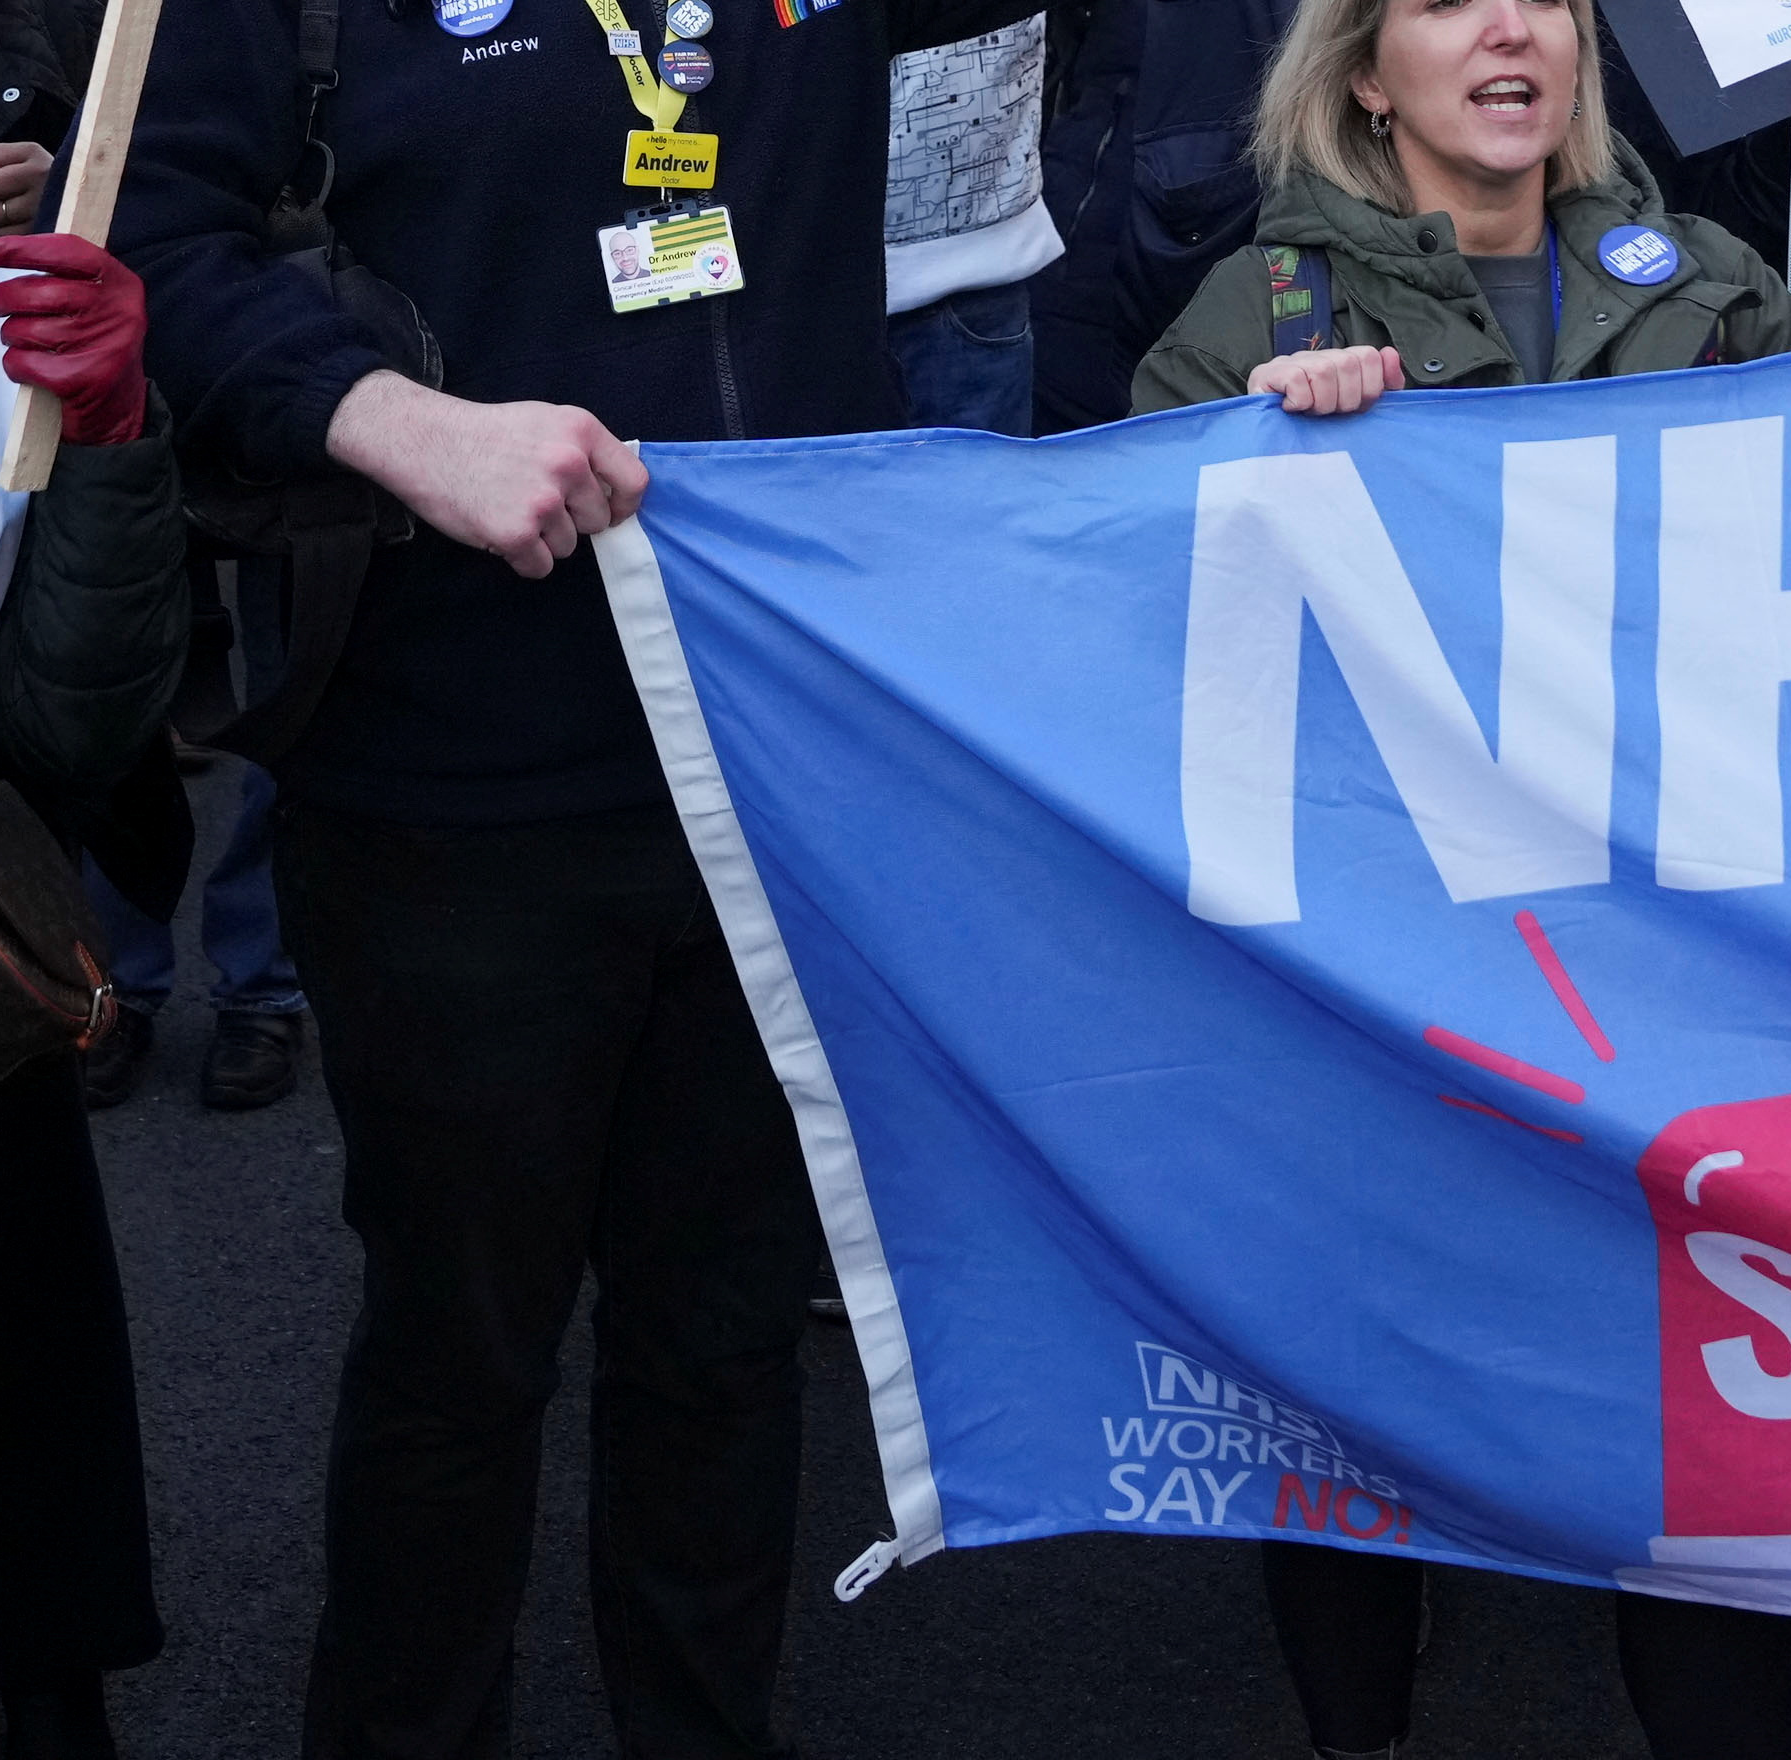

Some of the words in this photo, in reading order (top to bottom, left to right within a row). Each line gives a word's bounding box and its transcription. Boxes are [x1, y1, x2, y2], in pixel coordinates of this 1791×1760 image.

[441, 0, 468, 20] NHS
[461, 36, 539, 64] Andrew
[615, 39, 636, 48] NHS
[635, 152, 709, 173] Andrew
[661, 176, 681, 184] Doctor
[648, 255, 660, 265] Dr
[662, 250, 697, 263] Andrew
[1610, 243, 1638, 264] STAND
[1635, 231, 1661, 248] WITH
[1616, 252, 1644, 275] NHS
[1639, 241, 1669, 264] STAFF
[615, 289, 647, 300] Emergency
[1158, 1355, 1321, 1438] NHS
[1101, 1417, 1402, 1499] WORKERS
[1104, 1463, 1252, 1526] SAY
[1272, 1473, 1414, 1544] NO!
